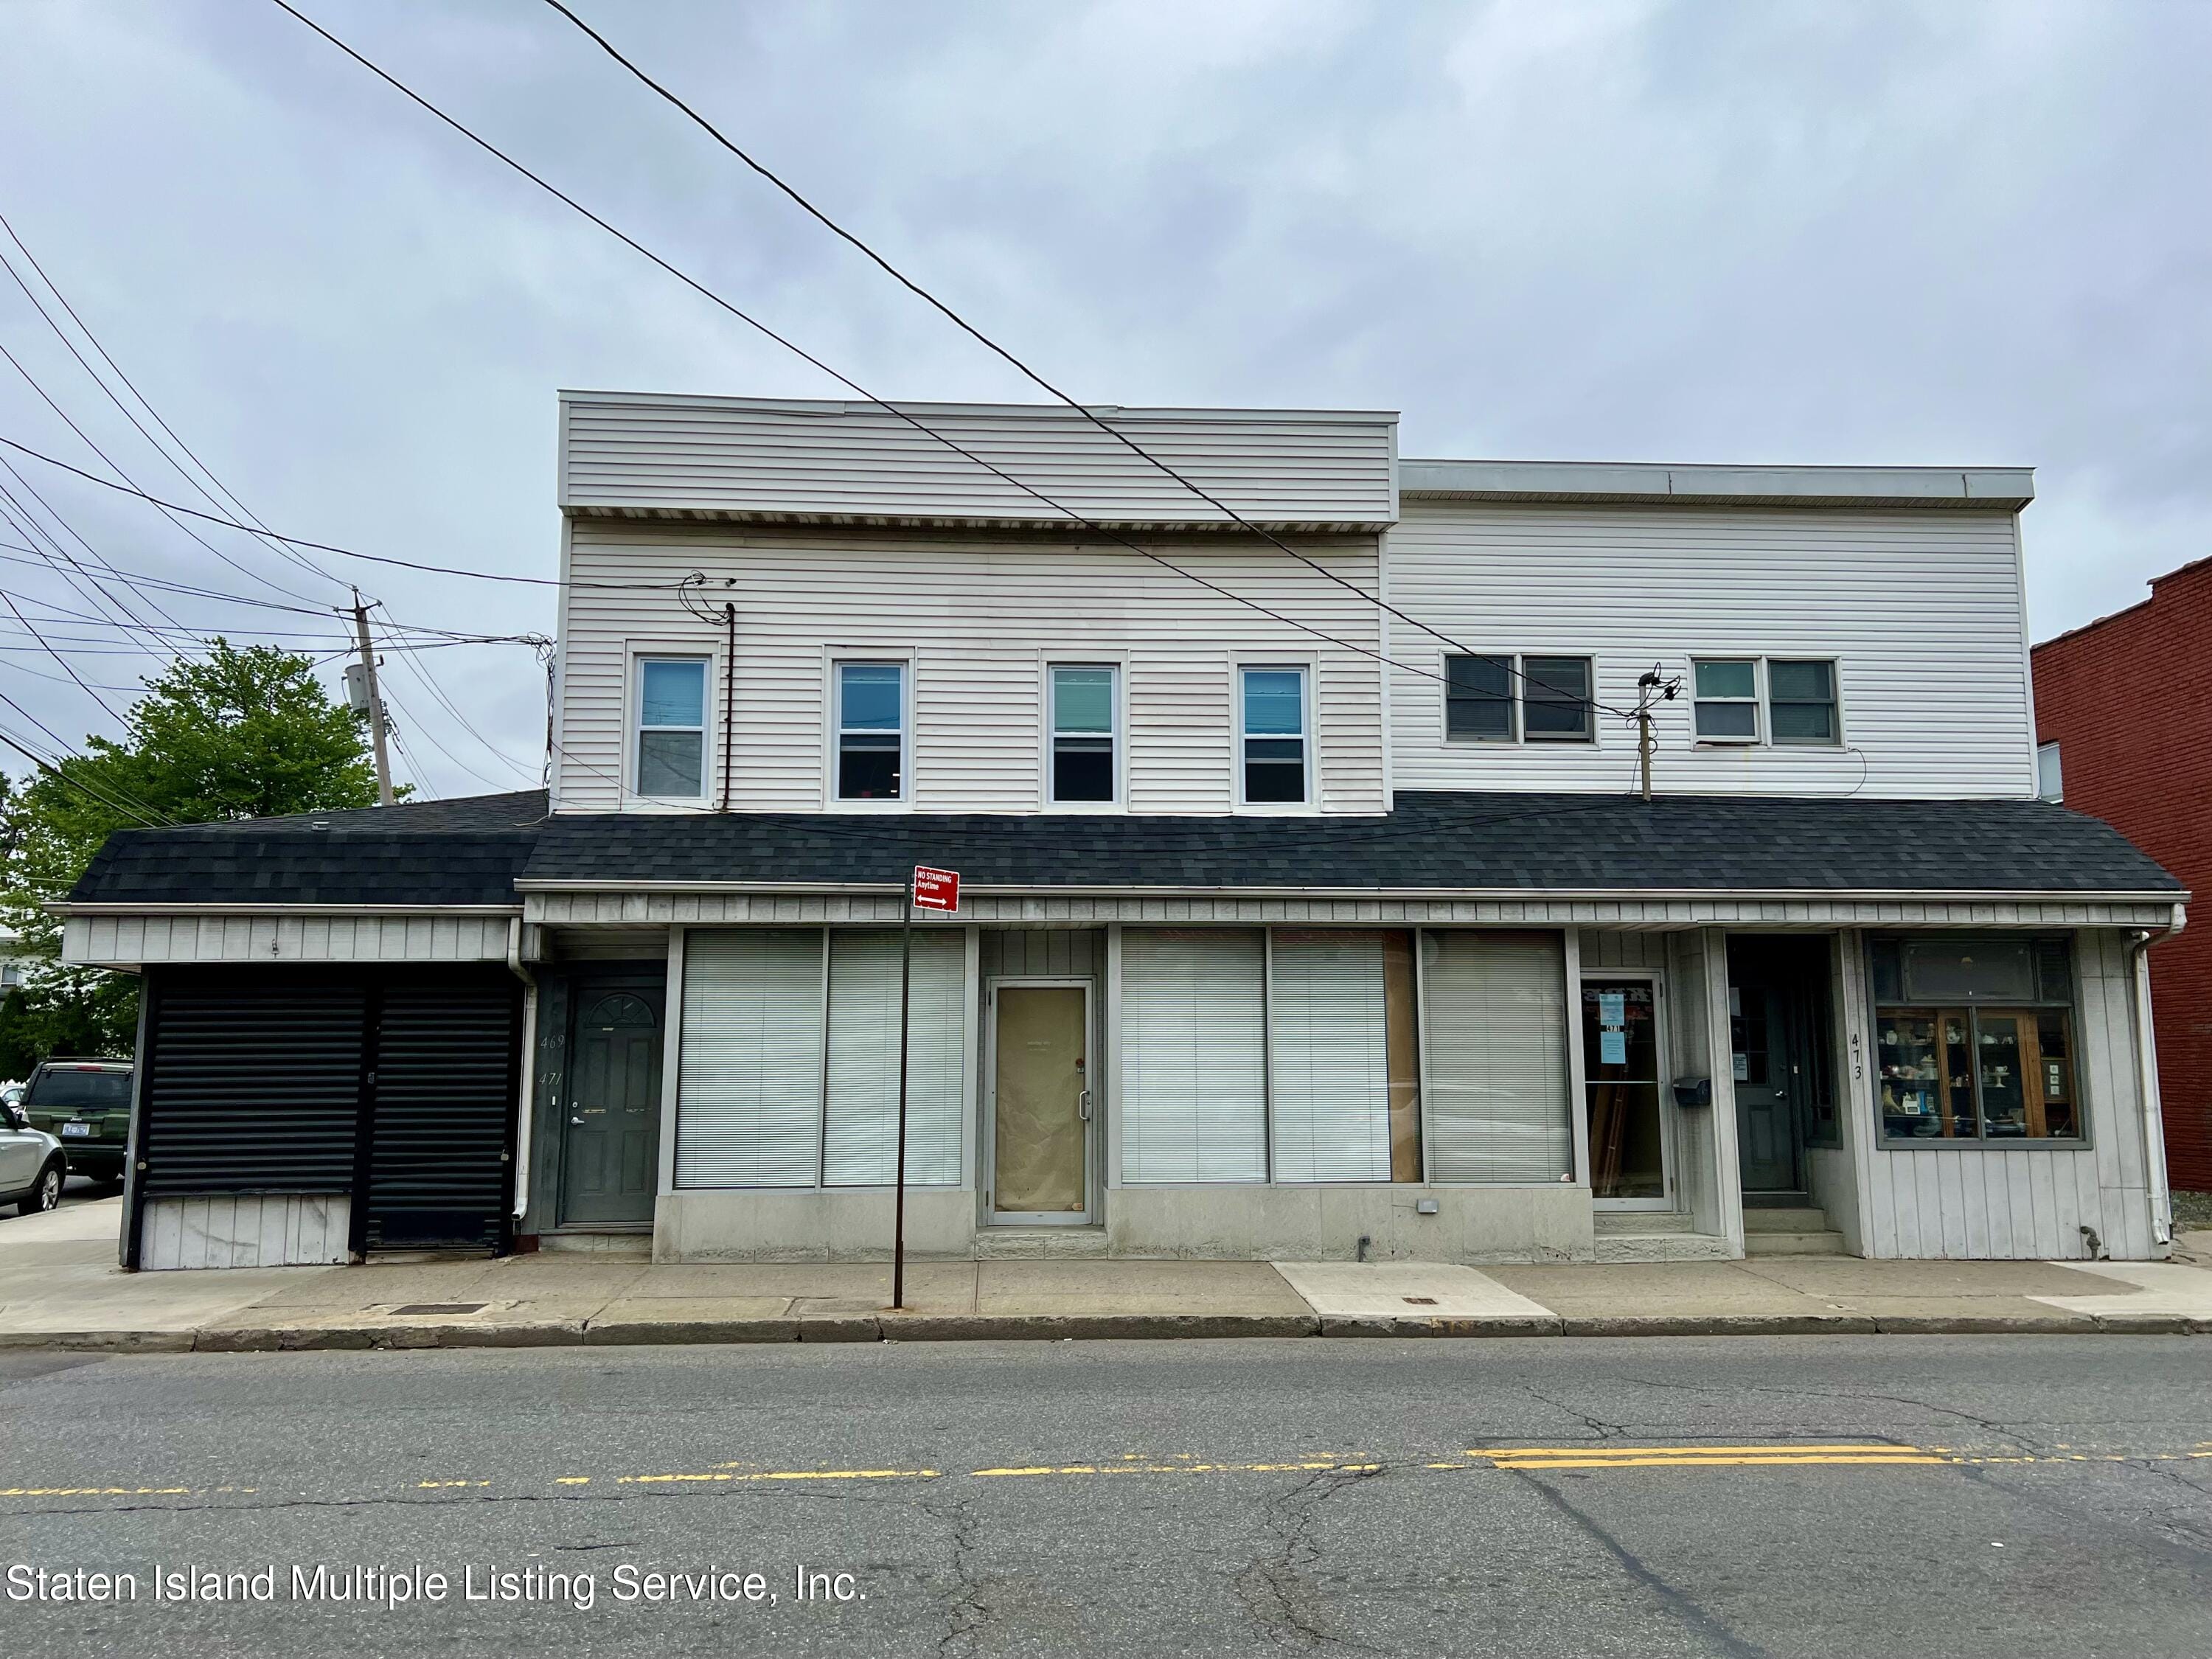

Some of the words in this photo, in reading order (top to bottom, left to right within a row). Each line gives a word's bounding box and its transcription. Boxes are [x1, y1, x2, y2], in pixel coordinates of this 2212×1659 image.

[917, 871, 925, 879] NO
[926, 872, 952, 883] STANDING
[917, 880, 939, 890] Anytime
[540, 1034, 565, 1048] 469
[1851, 1033, 1862, 1079] 473
[538, 1072, 562, 1085] 471
